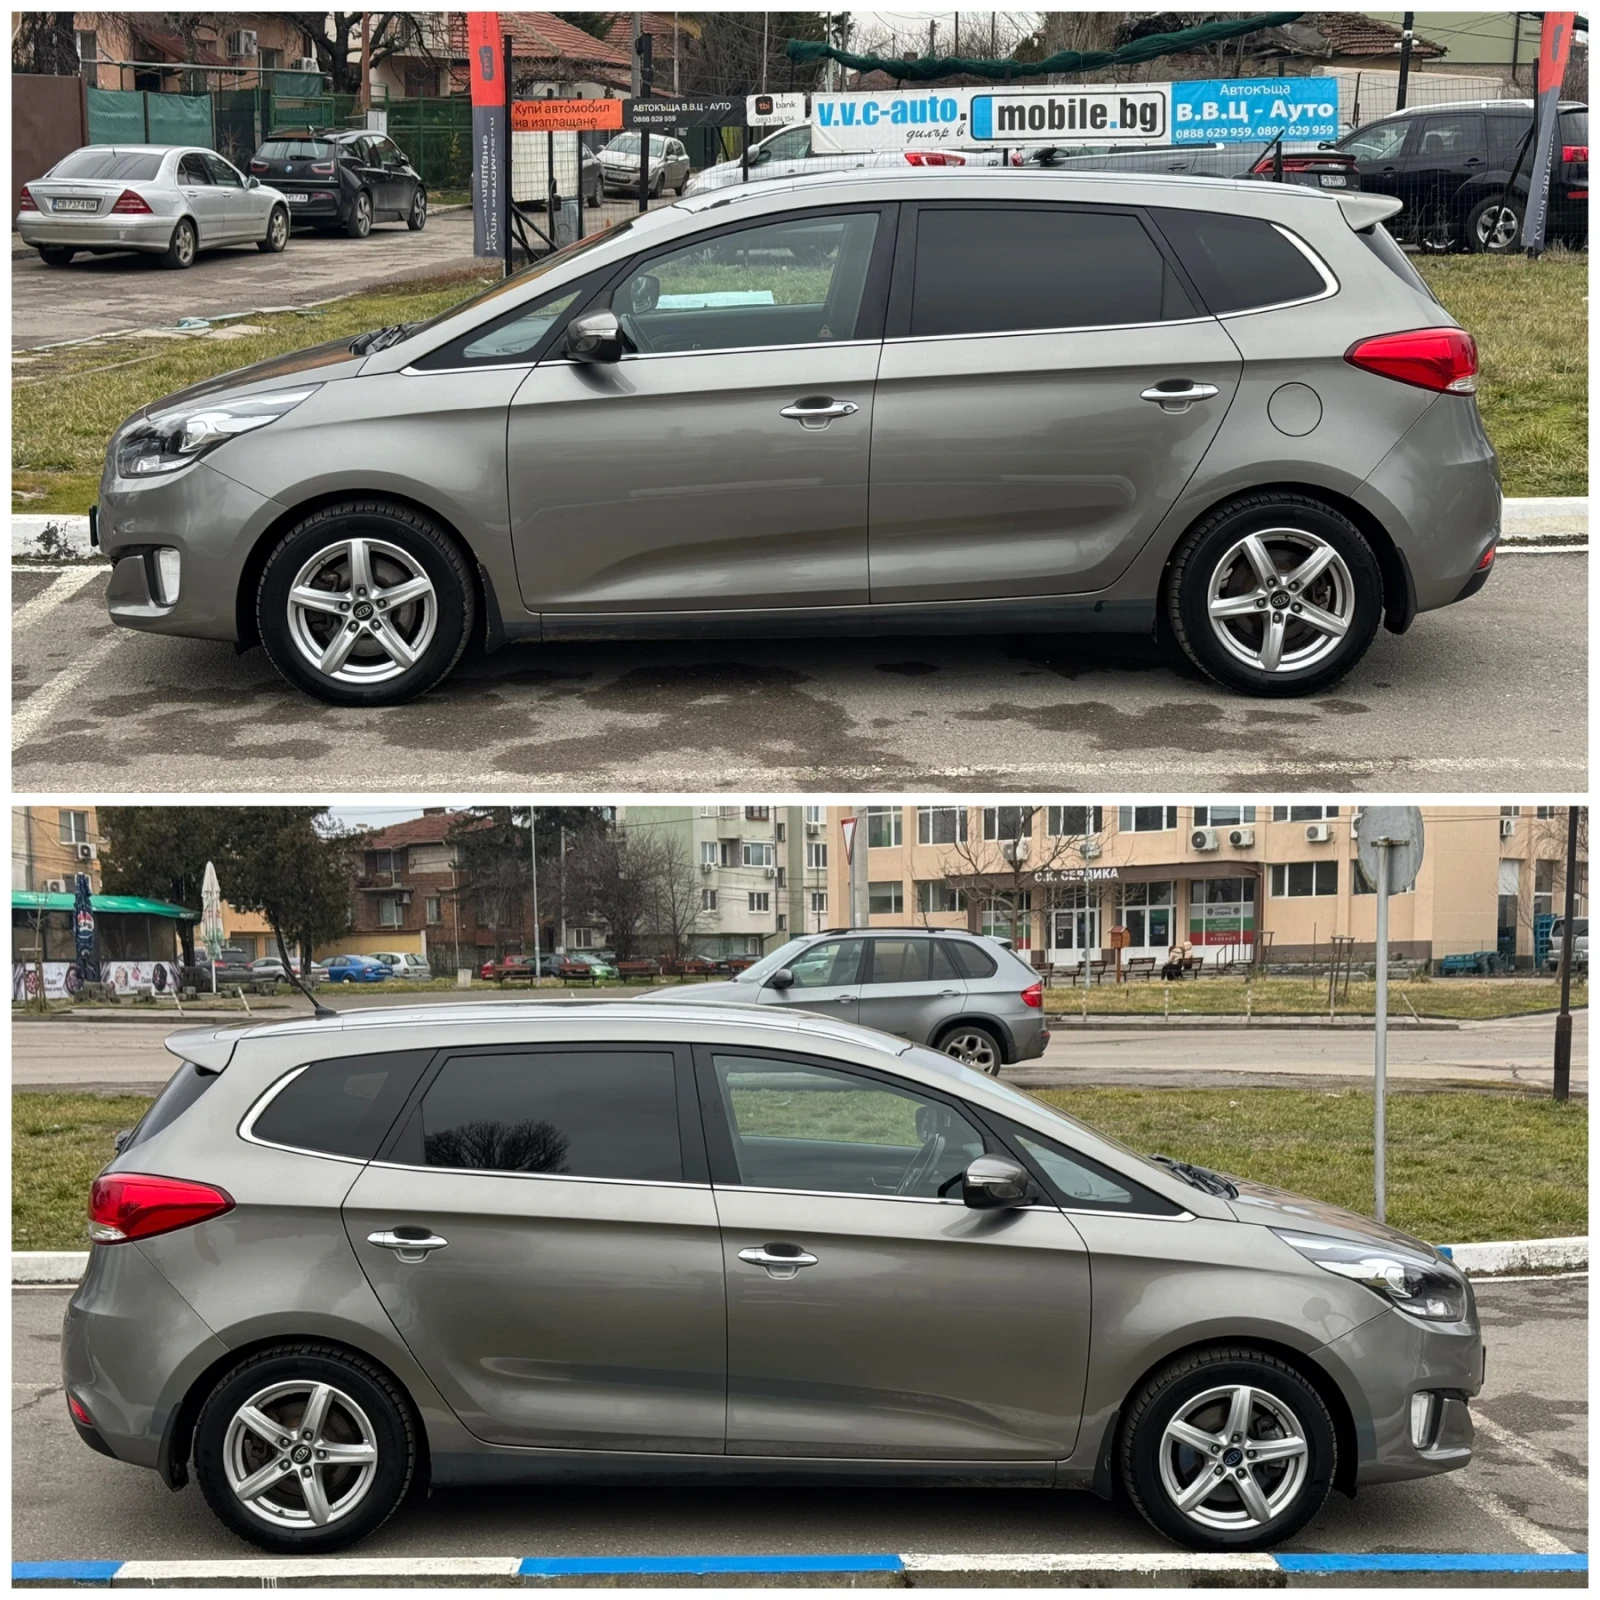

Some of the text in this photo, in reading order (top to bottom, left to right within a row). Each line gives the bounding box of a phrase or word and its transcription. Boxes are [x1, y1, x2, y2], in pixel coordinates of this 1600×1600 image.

[1220, 84, 1290, 96] Автокъща
[515, 103, 610, 115] Купи автомобил
[633, 103, 680, 113] АВТОКЪЩА
[682, 103, 703, 112] В.В.Ц
[710, 102, 731, 111] АУТО
[759, 100, 796, 110] tbi bank
[998, 98, 1157, 132] mobile.bg
[1177, 101, 1248, 123] В.В.Ц
[1270, 100, 1334, 122] Ауто
[515, 117, 598, 128] на изплащане
[906, 123, 966, 143] дилър в
[1176, 128, 1204, 139] 0888
[1207, 127, 1228, 138] 629
[1288, 125, 1310, 136] 629
[1312, 124, 1334, 135] 959
